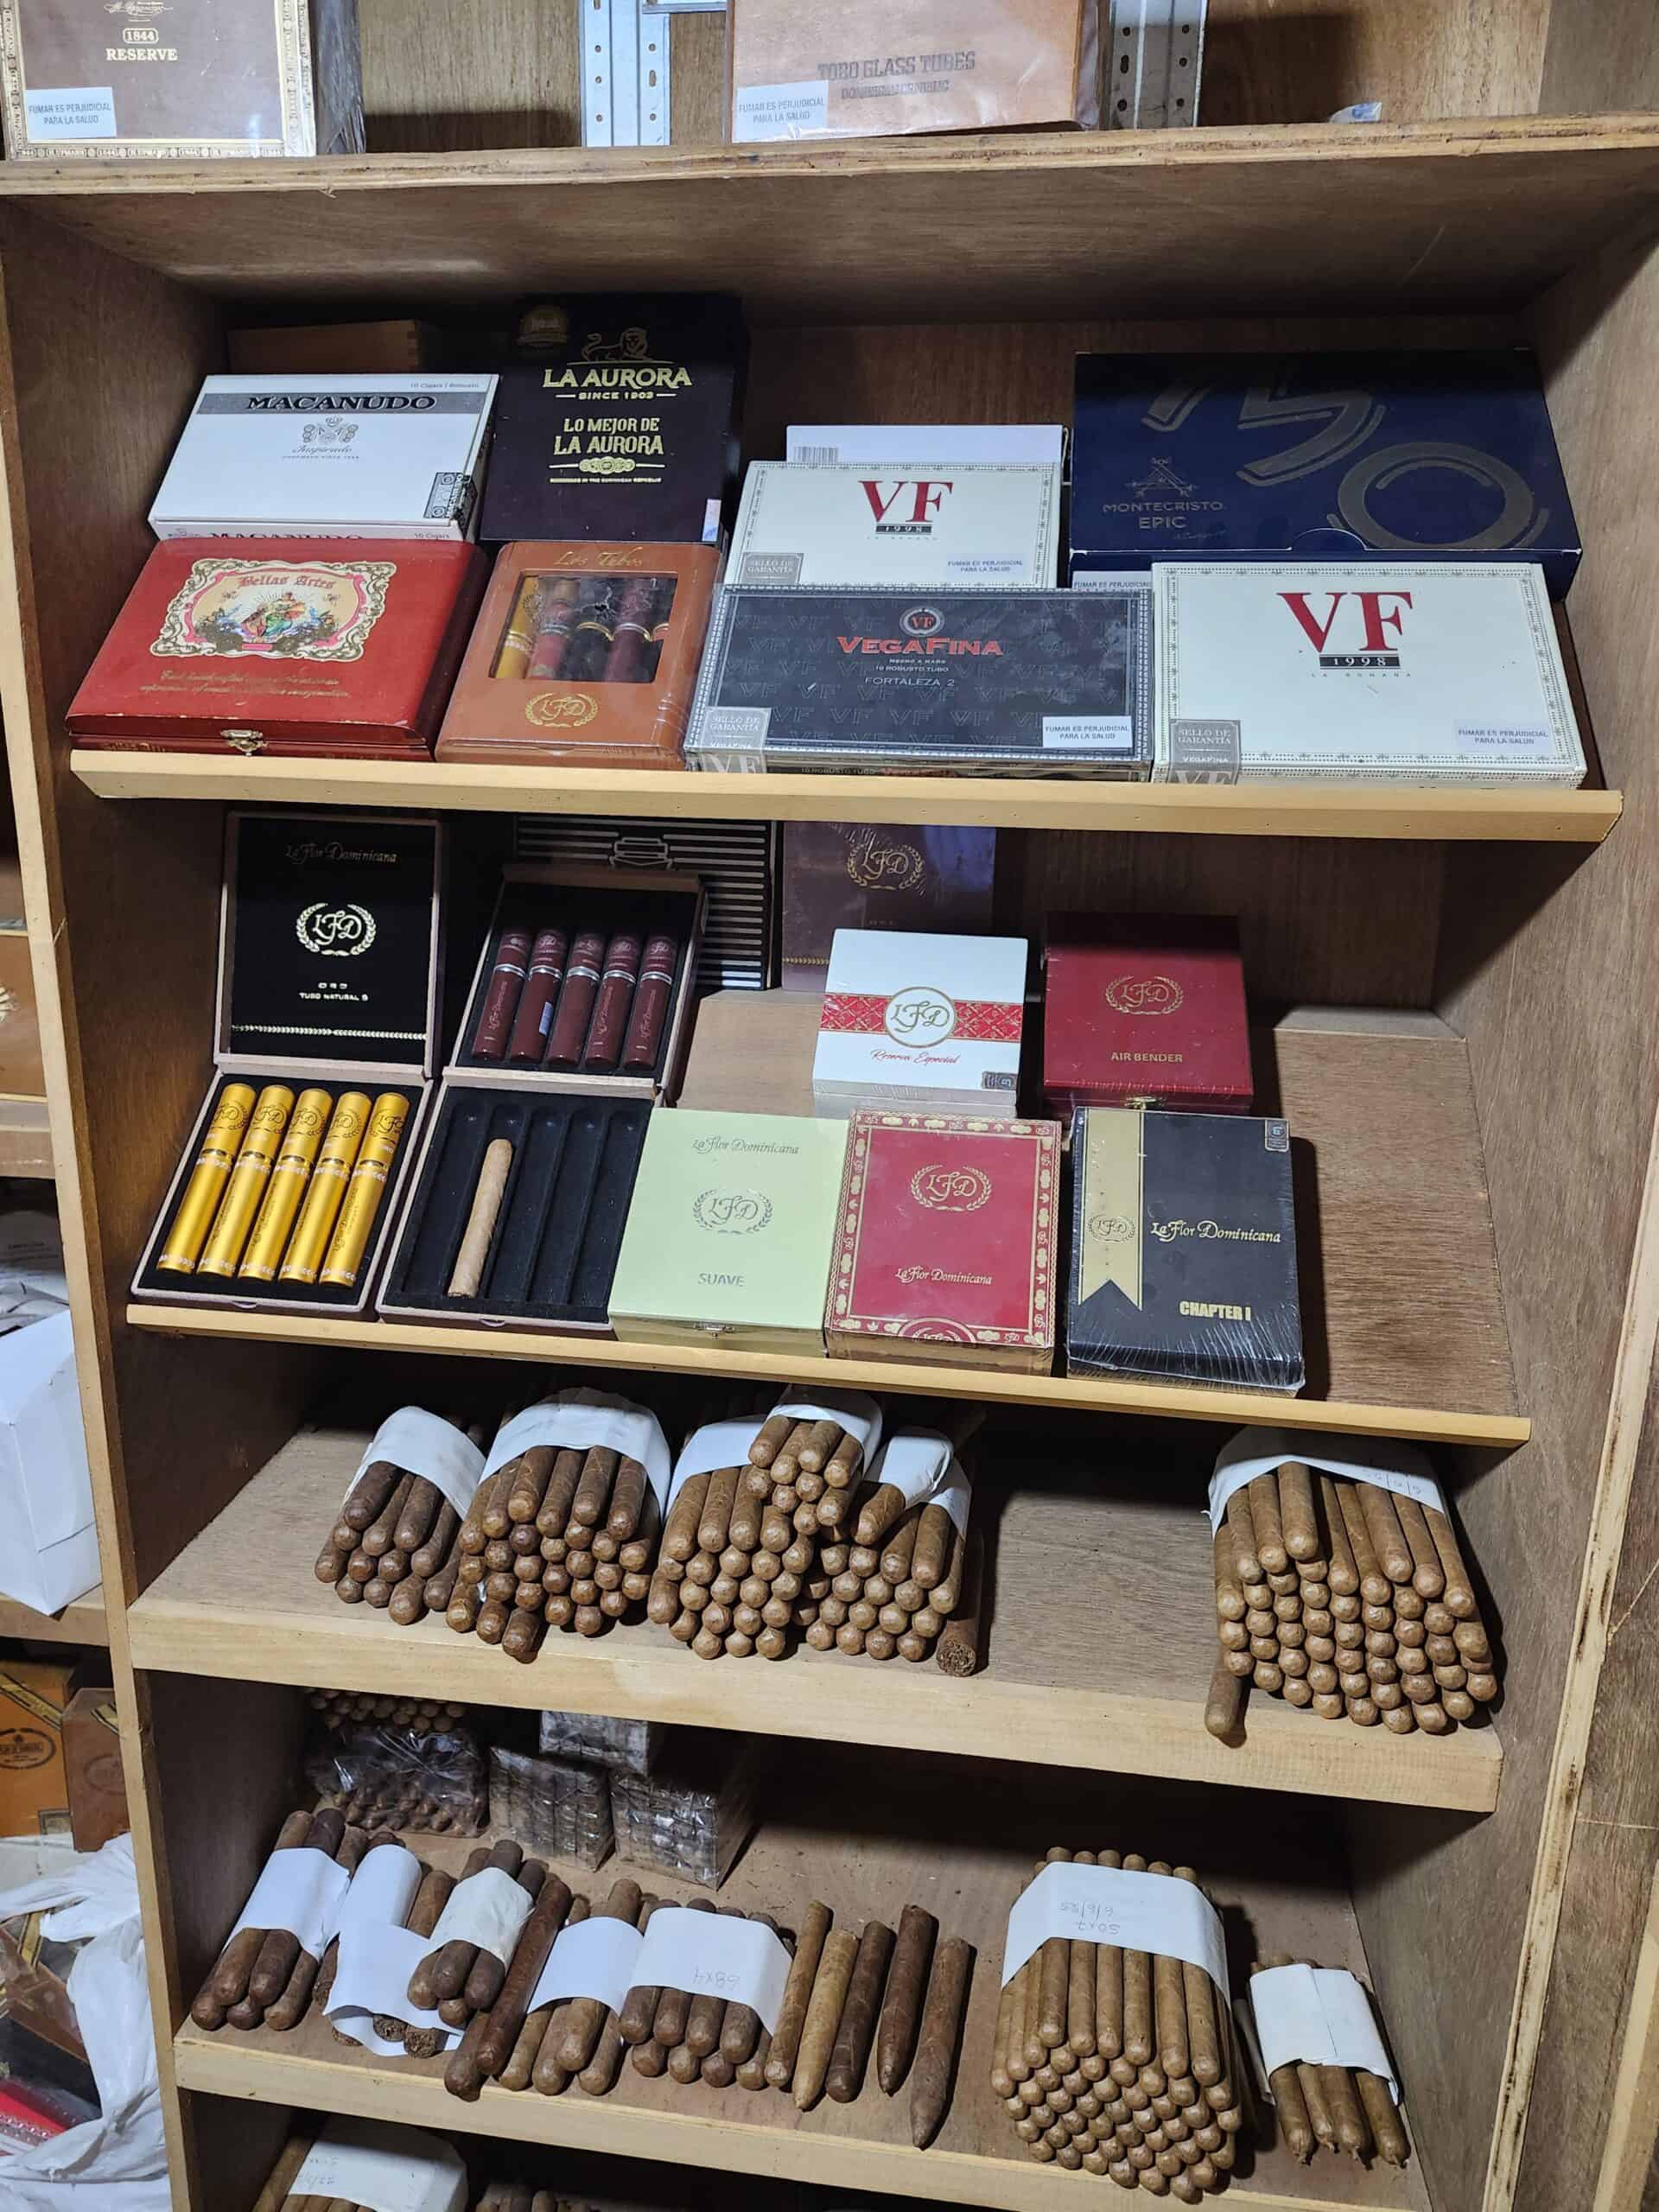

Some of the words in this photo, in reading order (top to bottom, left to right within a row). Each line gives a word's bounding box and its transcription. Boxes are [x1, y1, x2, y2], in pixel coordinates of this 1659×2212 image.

[127, 31, 155, 41] 1844
[105, 48, 178, 61] RESERVE
[863, 55, 917, 78] GLASS
[919, 50, 976, 72] TUBES
[739, 103, 765, 113] FUMAR
[766, 102, 777, 112] ES
[543, 368, 579, 388] LA
[581, 366, 693, 390] AURORA
[245, 395, 436, 410] MACANUDO
[578, 391, 620, 400] SINCE
[563, 418, 584, 432] LO
[588, 418, 638, 435] MEJOR
[641, 417, 660, 431] DE
[554, 435, 582, 454] LA
[587, 435, 664, 454] AURORA
[857, 480, 954, 524] VF
[1103, 500, 1224, 513] MONTECRISTO
[1139, 516, 1187, 530] EPIC
[238, 575, 290, 588] Bellas
[911, 615, 935, 629] VF
[1276, 591, 1414, 653] VF
[1332, 657, 1387, 666] 1998
[864, 676, 941, 687] FORTALEZA
[947, 677, 956, 687] 2
[327, 842, 397, 863] Dominicana
[861, 848, 909, 880] LFD
[311, 910, 363, 945] LFD
[1120, 979, 1170, 1007] LFD
[890, 1000, 950, 1034] LFD
[1111, 1051, 1132, 1063] AIR
[1134, 1052, 1183, 1064] BENDER
[730, 1139, 800, 1155] Dominicana
[925, 1168, 978, 1201] LFD
[707, 1194, 759, 1220] LFD
[1151, 1222, 1167, 1236] La
[1163, 1219, 1196, 1243] Flor
[1197, 1219, 1281, 1243] Dominicana
[698, 1272, 746, 1287] SUAVE
[895, 1268, 908, 1280] La
[906, 1265, 929, 1283] Flor
[931, 1268, 994, 1286] Dominicana
[1179, 1300, 1243, 1320] CHAPTER
[1243, 1306, 1251, 1321] I
